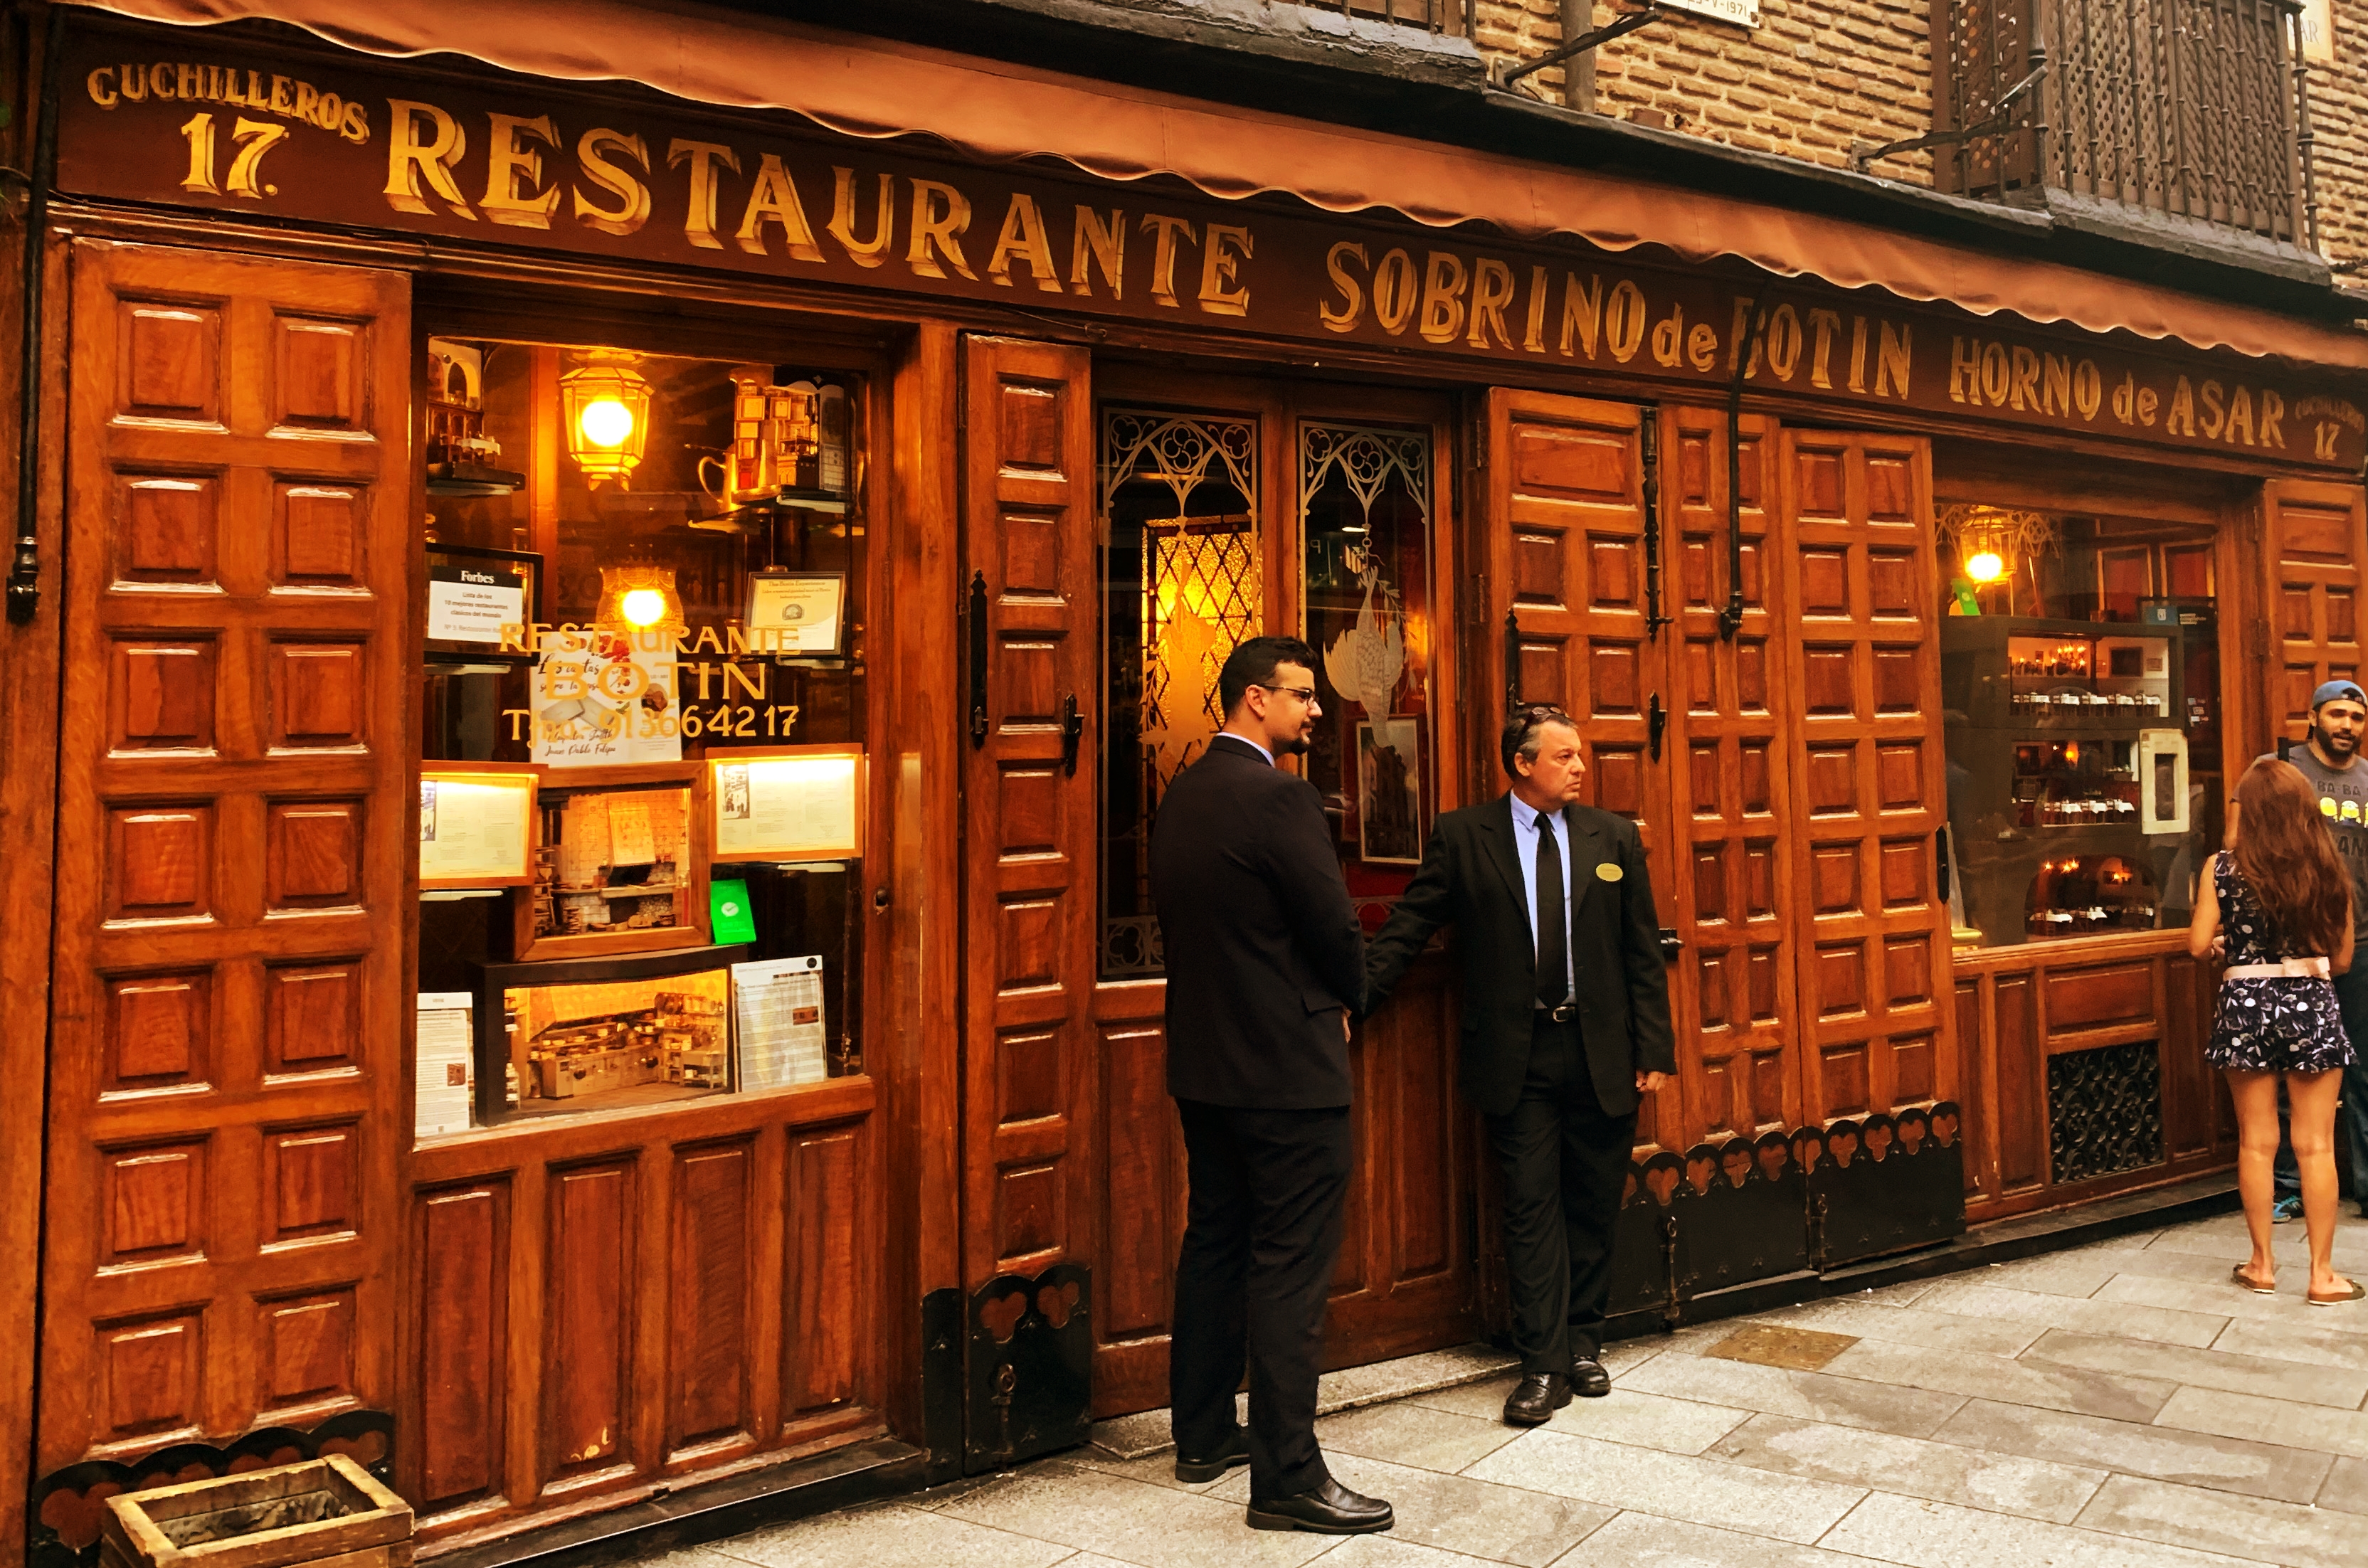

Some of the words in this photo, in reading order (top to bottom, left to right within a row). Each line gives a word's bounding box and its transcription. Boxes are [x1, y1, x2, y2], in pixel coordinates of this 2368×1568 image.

[88, 61, 371, 144] CUCHILLEROS
[383, 98, 1255, 317] RESTAURANTE
[1319, 240, 1647, 364] SOBRINO
[1651, 302, 1718, 373] de
[1948, 334, 2102, 422] HORNO
[2112, 372, 2159, 427] de
[2166, 374, 2286, 449] ASAR
[2315, 420, 2340, 461] 17
[460, 570, 495, 584] Forbes
[500, 623, 802, 655] RESTAURANTE
[545, 662, 766, 700] BOTIN
